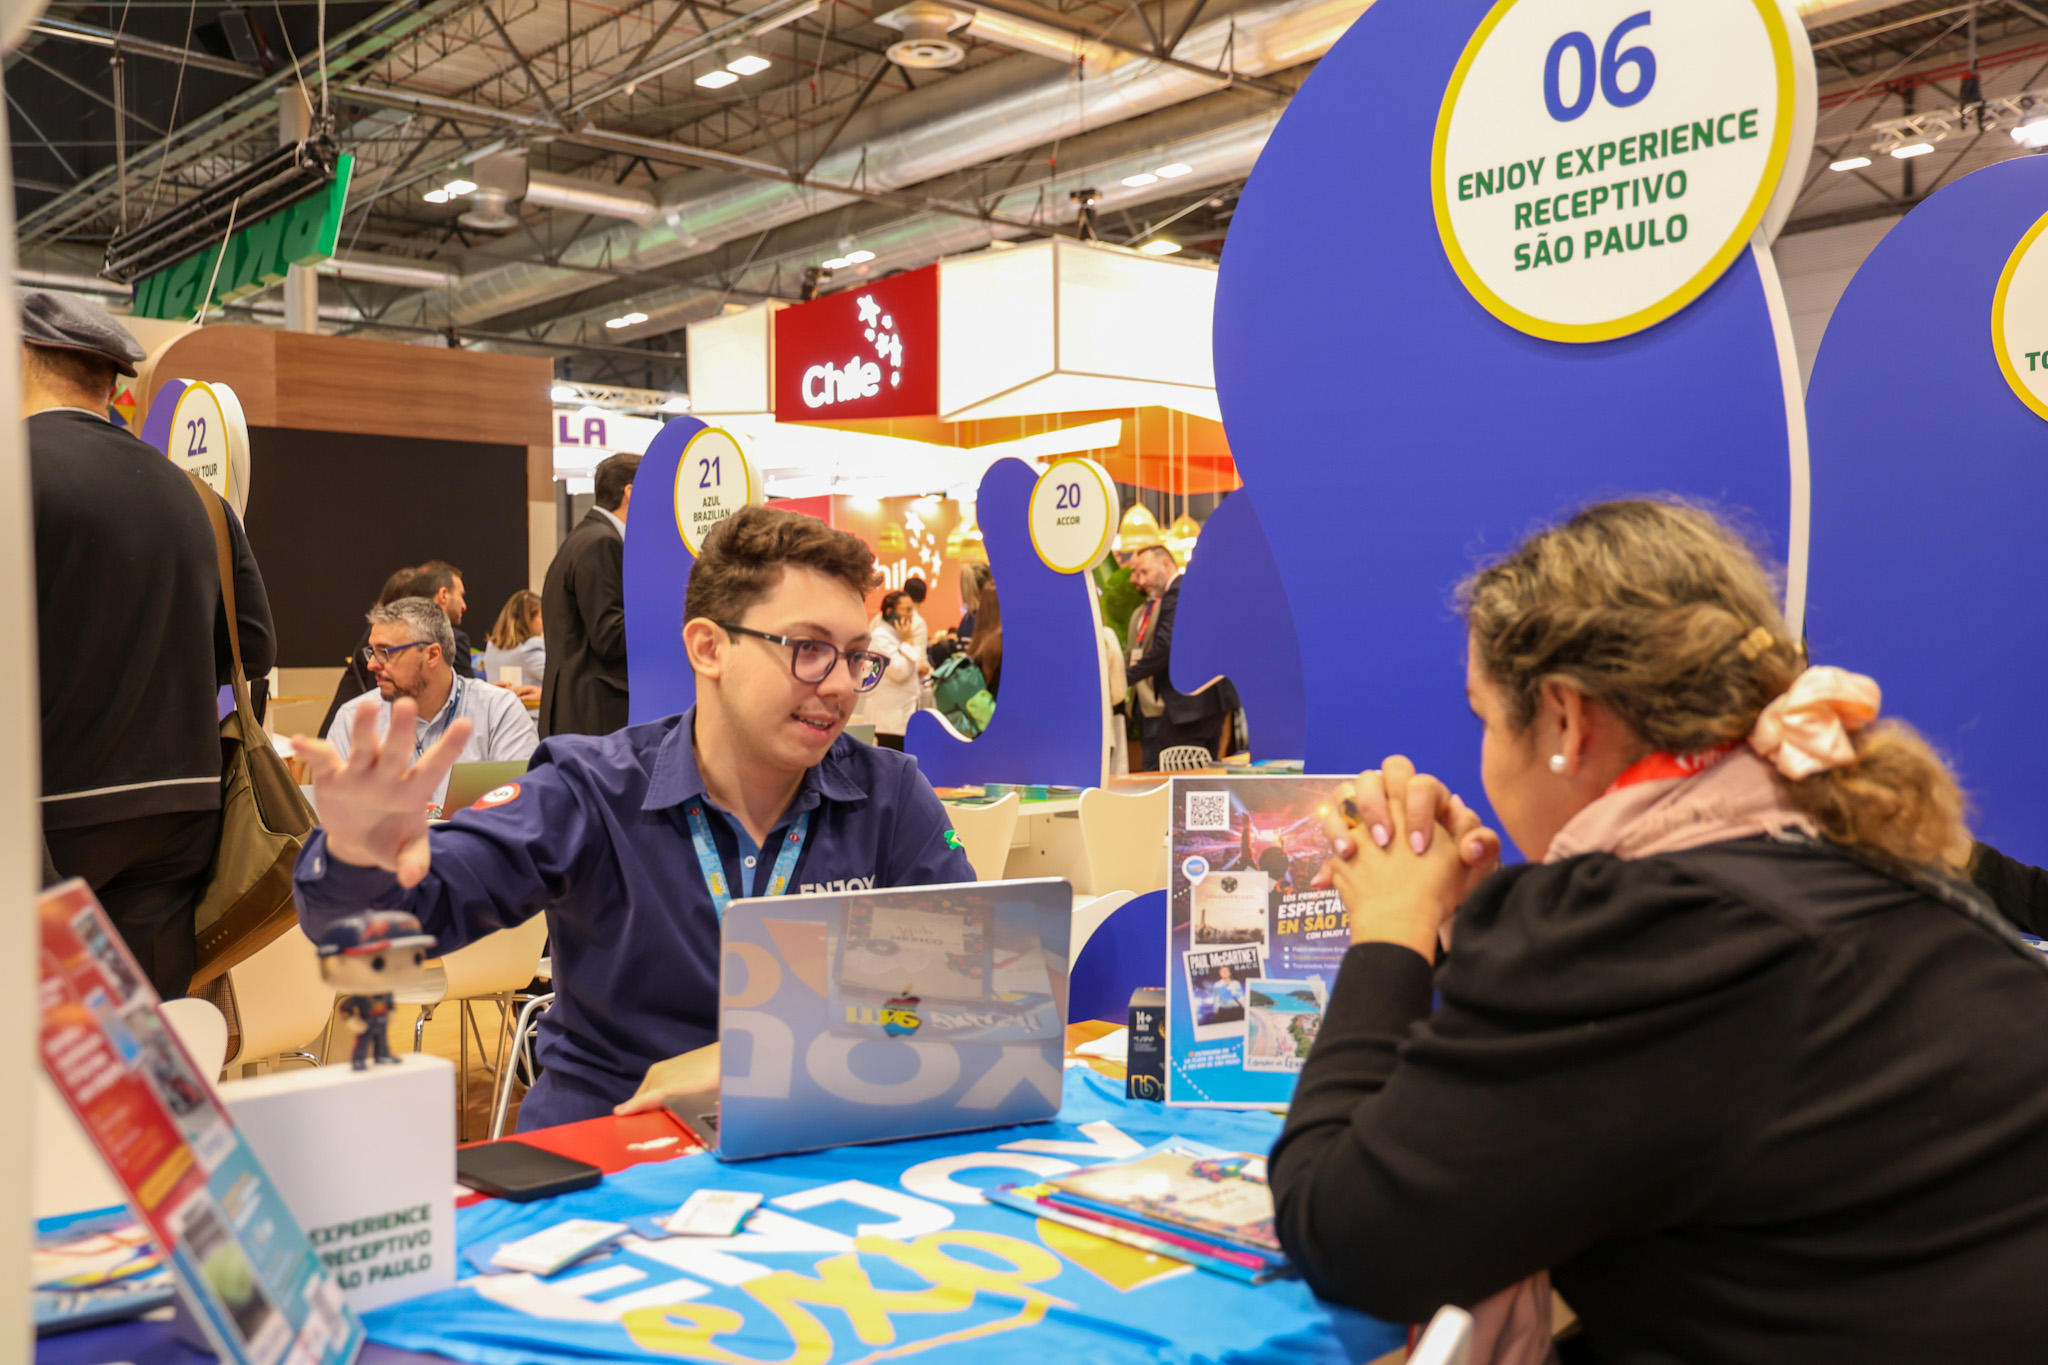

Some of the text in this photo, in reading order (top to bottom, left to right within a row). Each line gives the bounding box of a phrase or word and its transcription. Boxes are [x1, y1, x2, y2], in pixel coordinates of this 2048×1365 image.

[1543, 10, 1657, 123] 06
[1458, 108, 1759, 201] ENJOY EXPERIENCE
[1514, 169, 1688, 231] RECEPTIVO
[1514, 213, 1688, 272] SÃO PAULO
[802, 355, 881, 408] Chile
[186, 417, 208, 457] 22
[201, 463, 218, 478] TOUR
[699, 456, 721, 488] 21
[702, 496, 721, 507] AZUL
[1056, 483, 1081, 509] 20
[693, 508, 731, 522] BRAZILIAN
[1056, 516, 1080, 526] ACCOR
[1277, 919, 1300, 935] EN
[1304, 914, 1336, 932] SÃO
[1322, 929, 1344, 938] ENJOY
[1190, 949, 1257, 970] PAUL McCARTNEY
